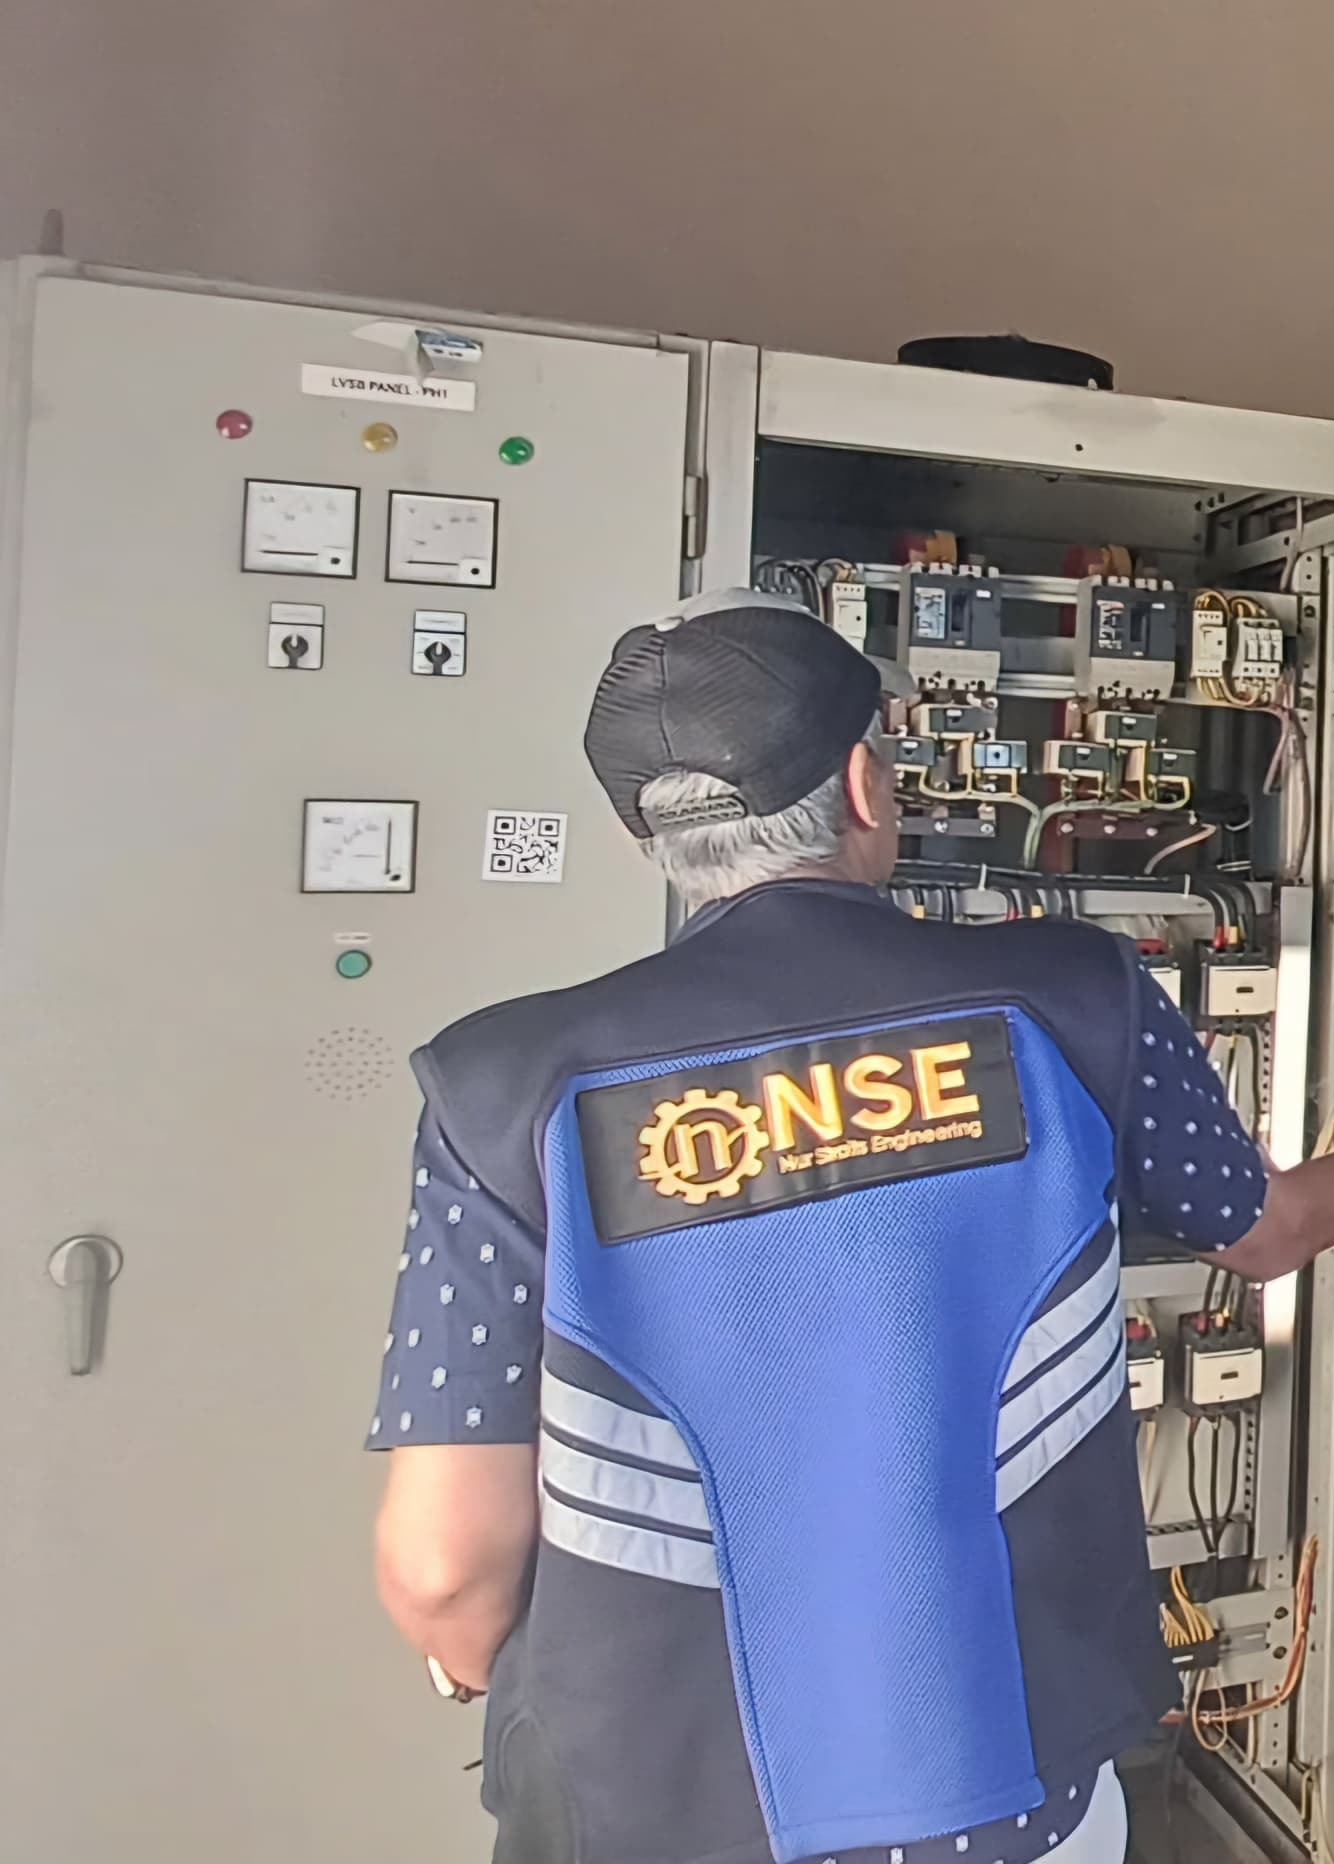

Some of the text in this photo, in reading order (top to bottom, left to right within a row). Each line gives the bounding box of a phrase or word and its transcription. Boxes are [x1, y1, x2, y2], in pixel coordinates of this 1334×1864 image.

[369, 381, 412, 395] PANEL
[762, 1041, 980, 1152] NSE
[778, 1151, 814, 1174] Nur
[870, 1119, 984, 1153] Engineering
